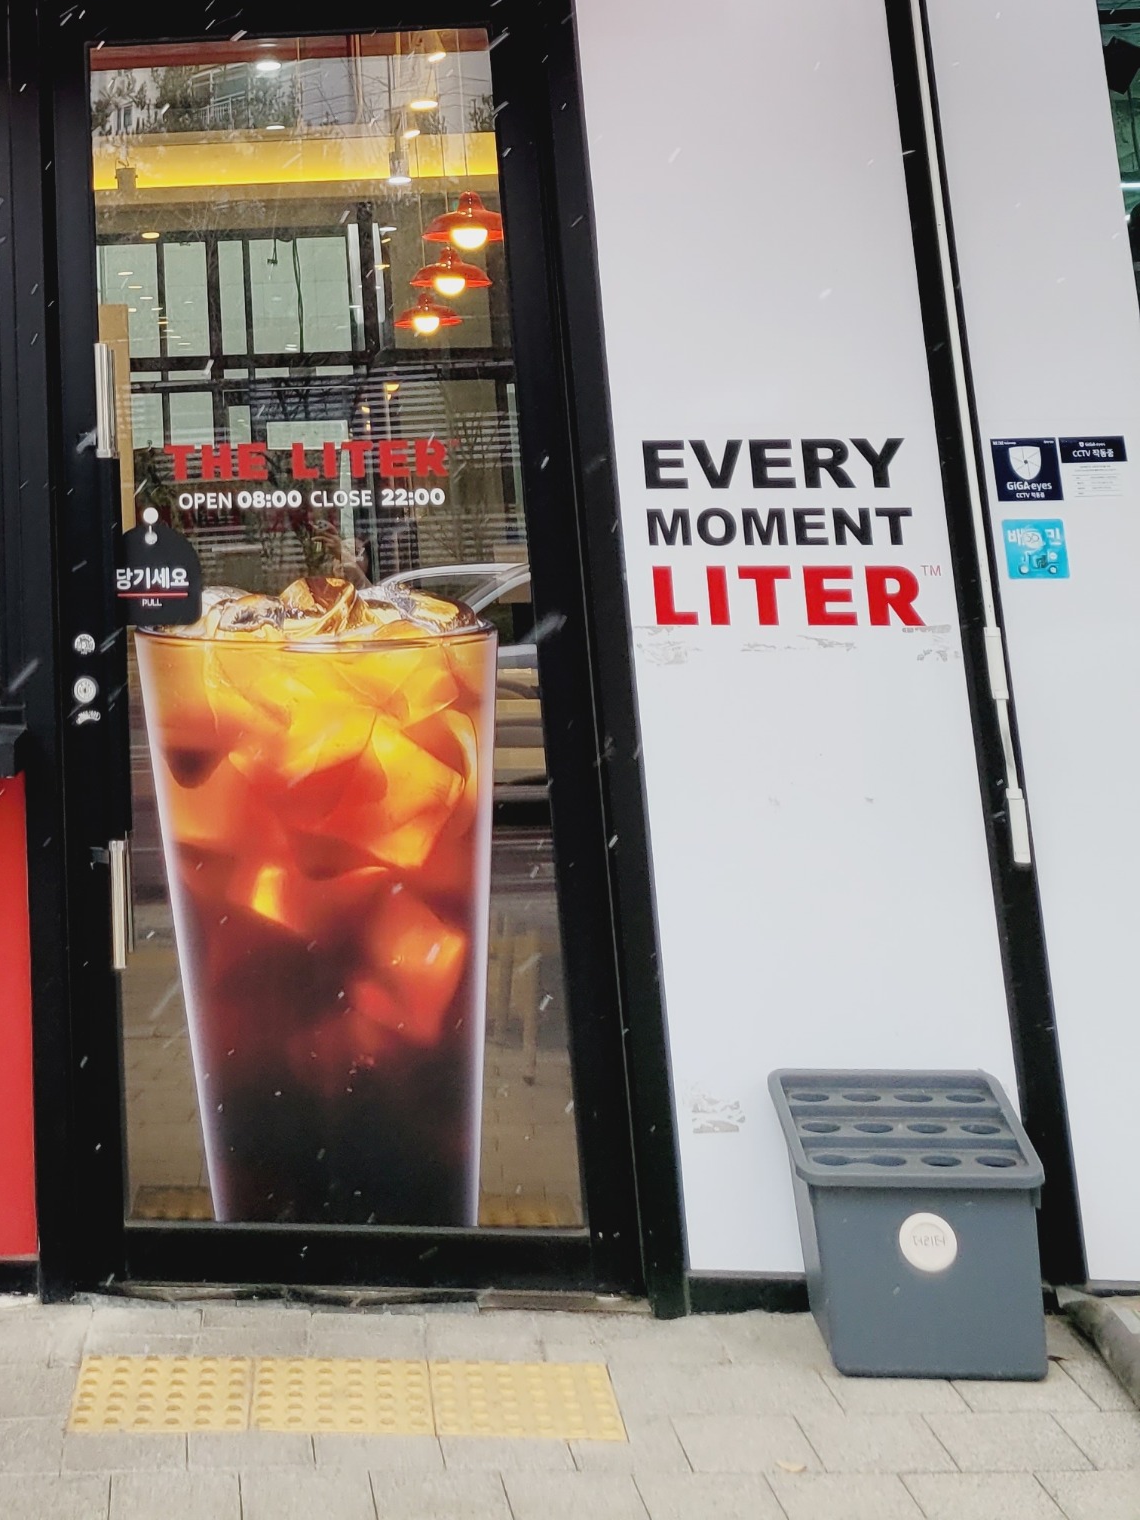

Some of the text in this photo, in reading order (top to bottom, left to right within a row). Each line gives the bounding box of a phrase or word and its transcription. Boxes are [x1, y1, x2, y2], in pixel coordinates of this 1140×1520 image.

[164, 439, 448, 481] THE LITER
[642, 437, 905, 490] EVERY
[1072, 448, 1114, 458] CCTV 작동중
[179, 488, 446, 509] OPEN 08:00 CLOSE 22:00
[646, 507, 913, 547] MOMENT
[116, 567, 189, 591] 당기세요
[141, 598, 163, 607] PULL
[652, 565, 926, 627] LITER
